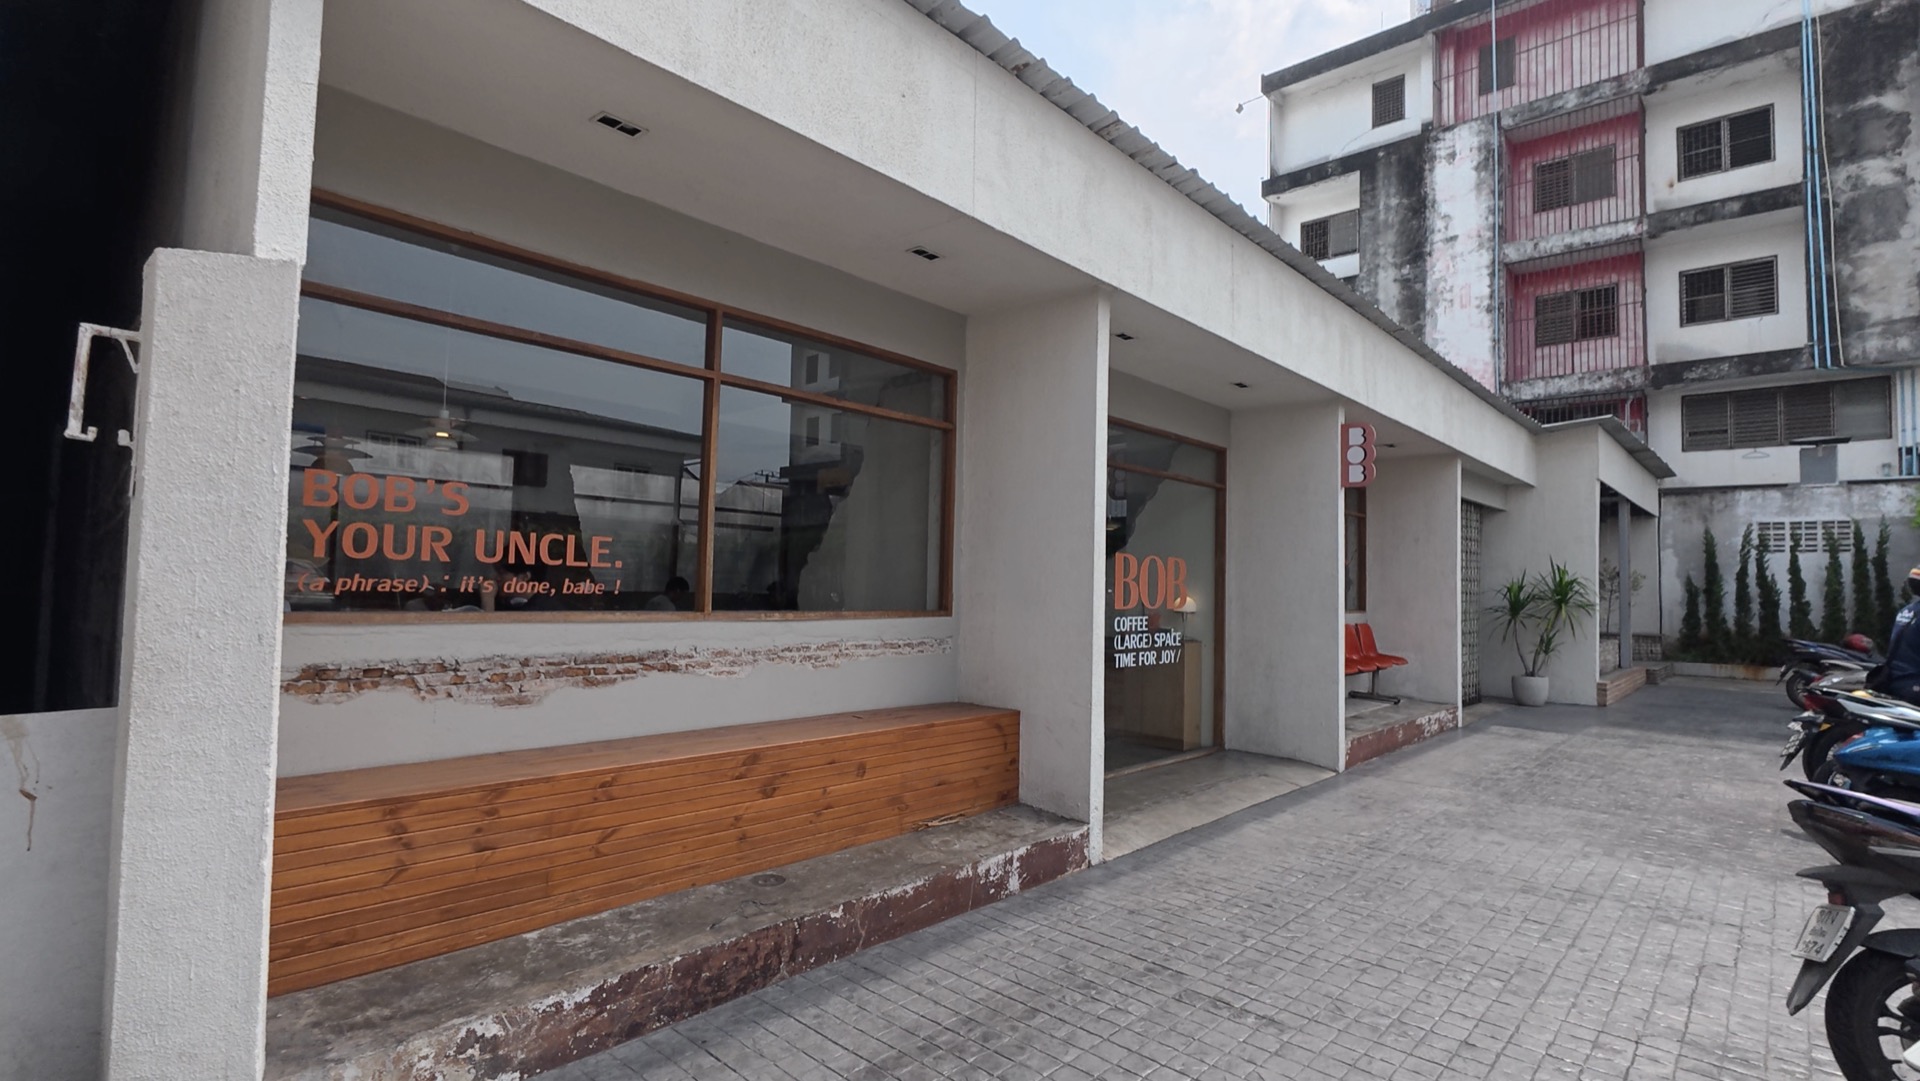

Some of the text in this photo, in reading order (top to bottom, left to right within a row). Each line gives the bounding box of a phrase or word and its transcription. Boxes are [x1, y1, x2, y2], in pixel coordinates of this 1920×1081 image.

[1346, 427, 1365, 483] BOB
[302, 468, 470, 516] BOB'S
[302, 519, 623, 568] YOUR UNCLE.
[334, 573, 429, 595] phrase)
[460, 575, 494, 592] it's
[502, 576, 556, 596] done,
[562, 578, 605, 595] babe
[1114, 552, 1188, 610] BOB
[1114, 616, 1149, 632] COFFEE
[1114, 632, 1182, 650] (LARGE) SPACE
[1114, 652, 1137, 668] TIME
[1139, 650, 1157, 666] FOR
